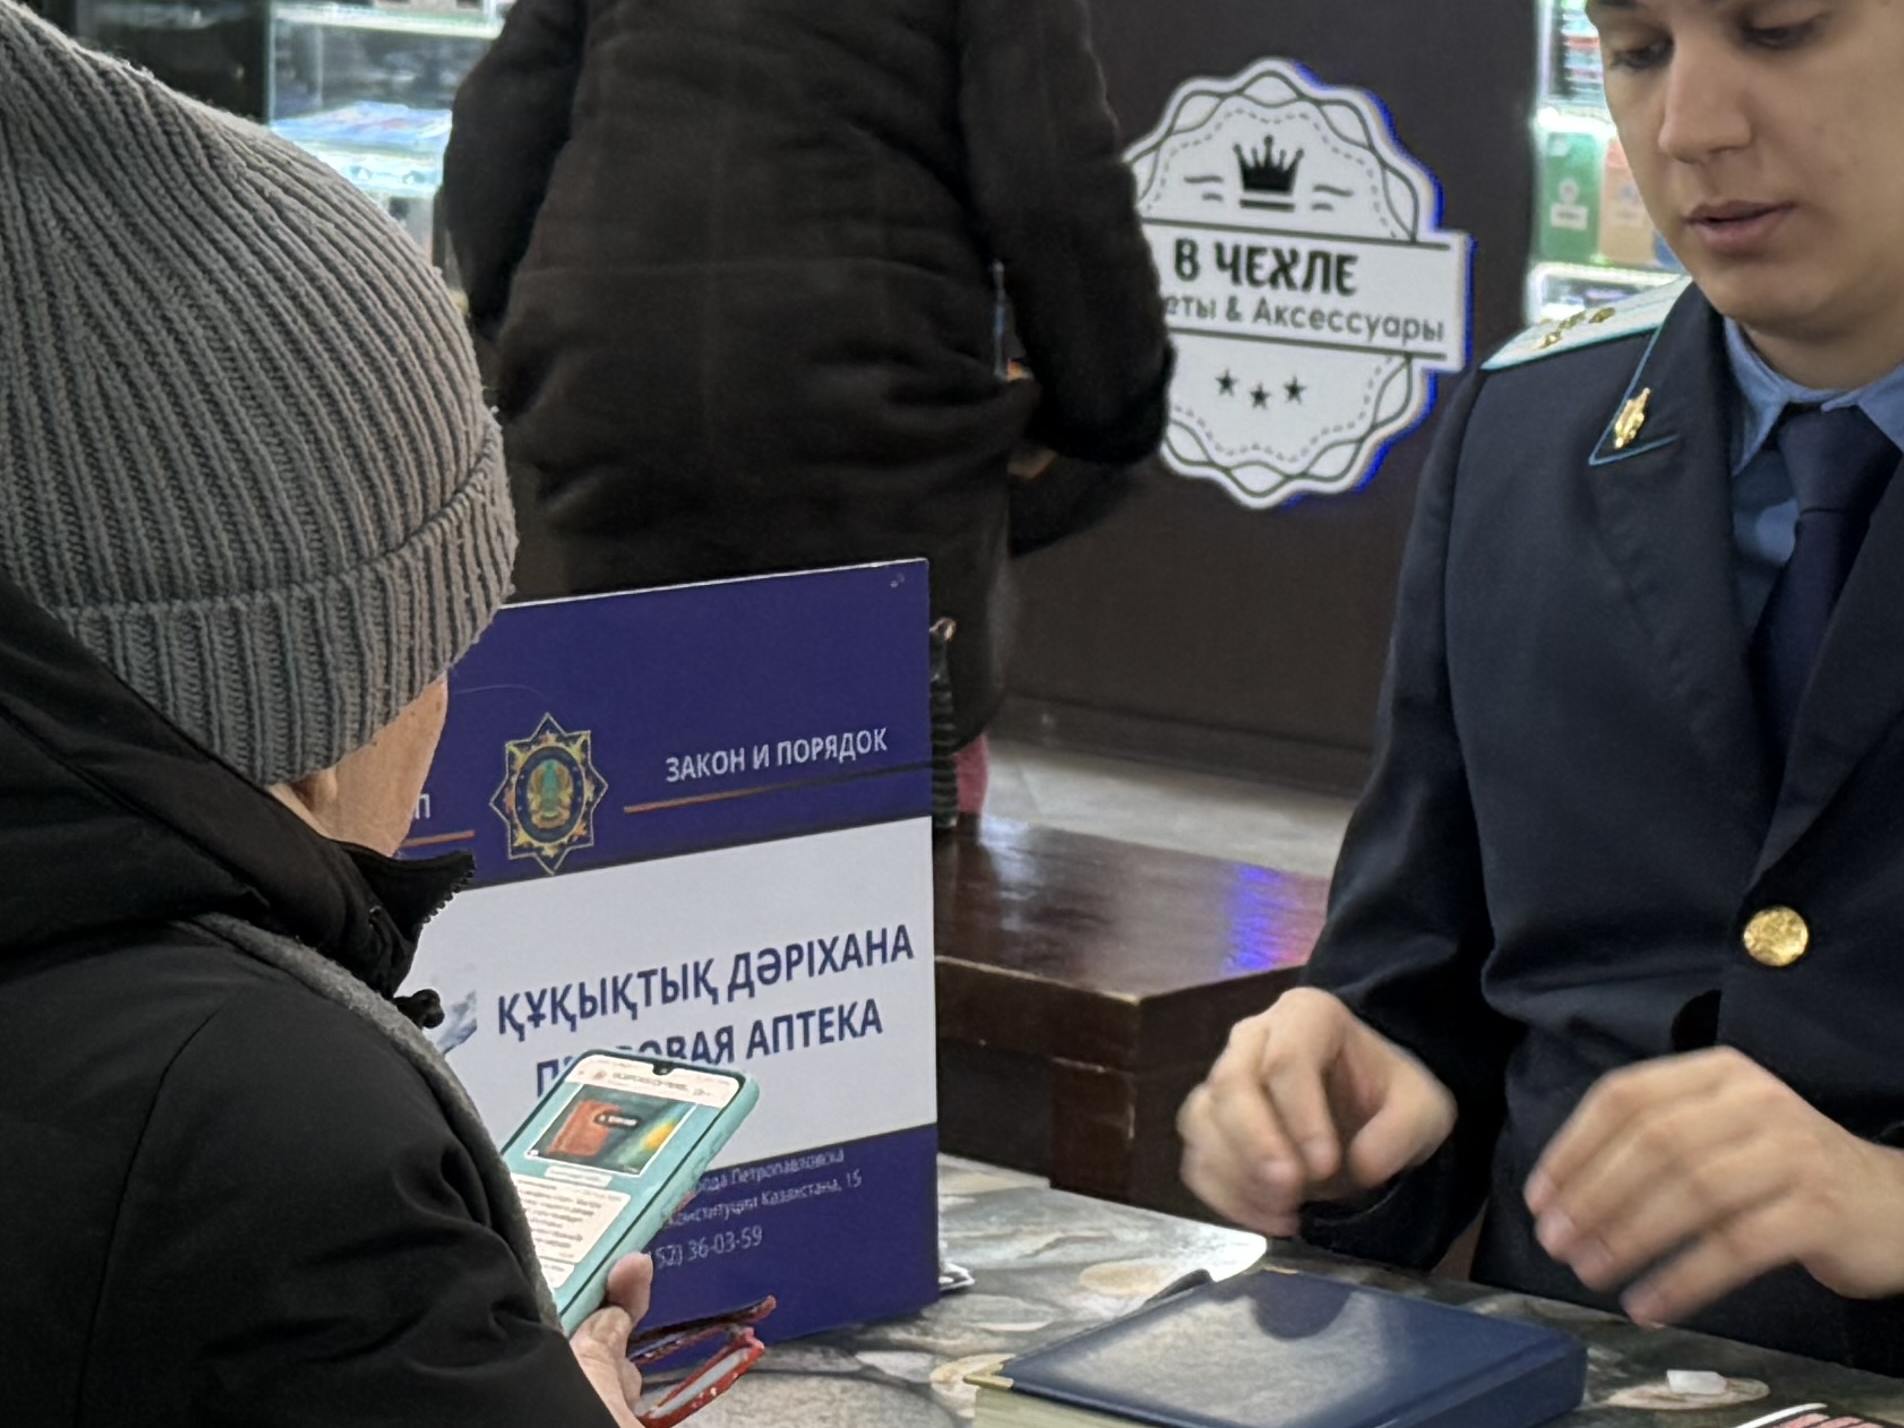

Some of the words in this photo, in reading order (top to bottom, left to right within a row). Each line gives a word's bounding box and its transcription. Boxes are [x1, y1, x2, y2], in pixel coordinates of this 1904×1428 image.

[1174, 237, 1200, 282] В
[1214, 239, 1358, 295] ЧЕХЛЕ
[1225, 295, 1242, 322] &
[1252, 300, 1445, 343] Аксессуары
[665, 747, 745, 782] ЗАКОН
[752, 744, 769, 770] И
[777, 728, 888, 766] ПОРЯДОК
[497, 957, 719, 1042] ҚҰҚЫҚТЫҚ
[726, 923, 915, 1003] ДӘРІХАНА
[745, 998, 884, 1060] АПТЕКА
[688, 1225, 763, 1262] 36-03-59
